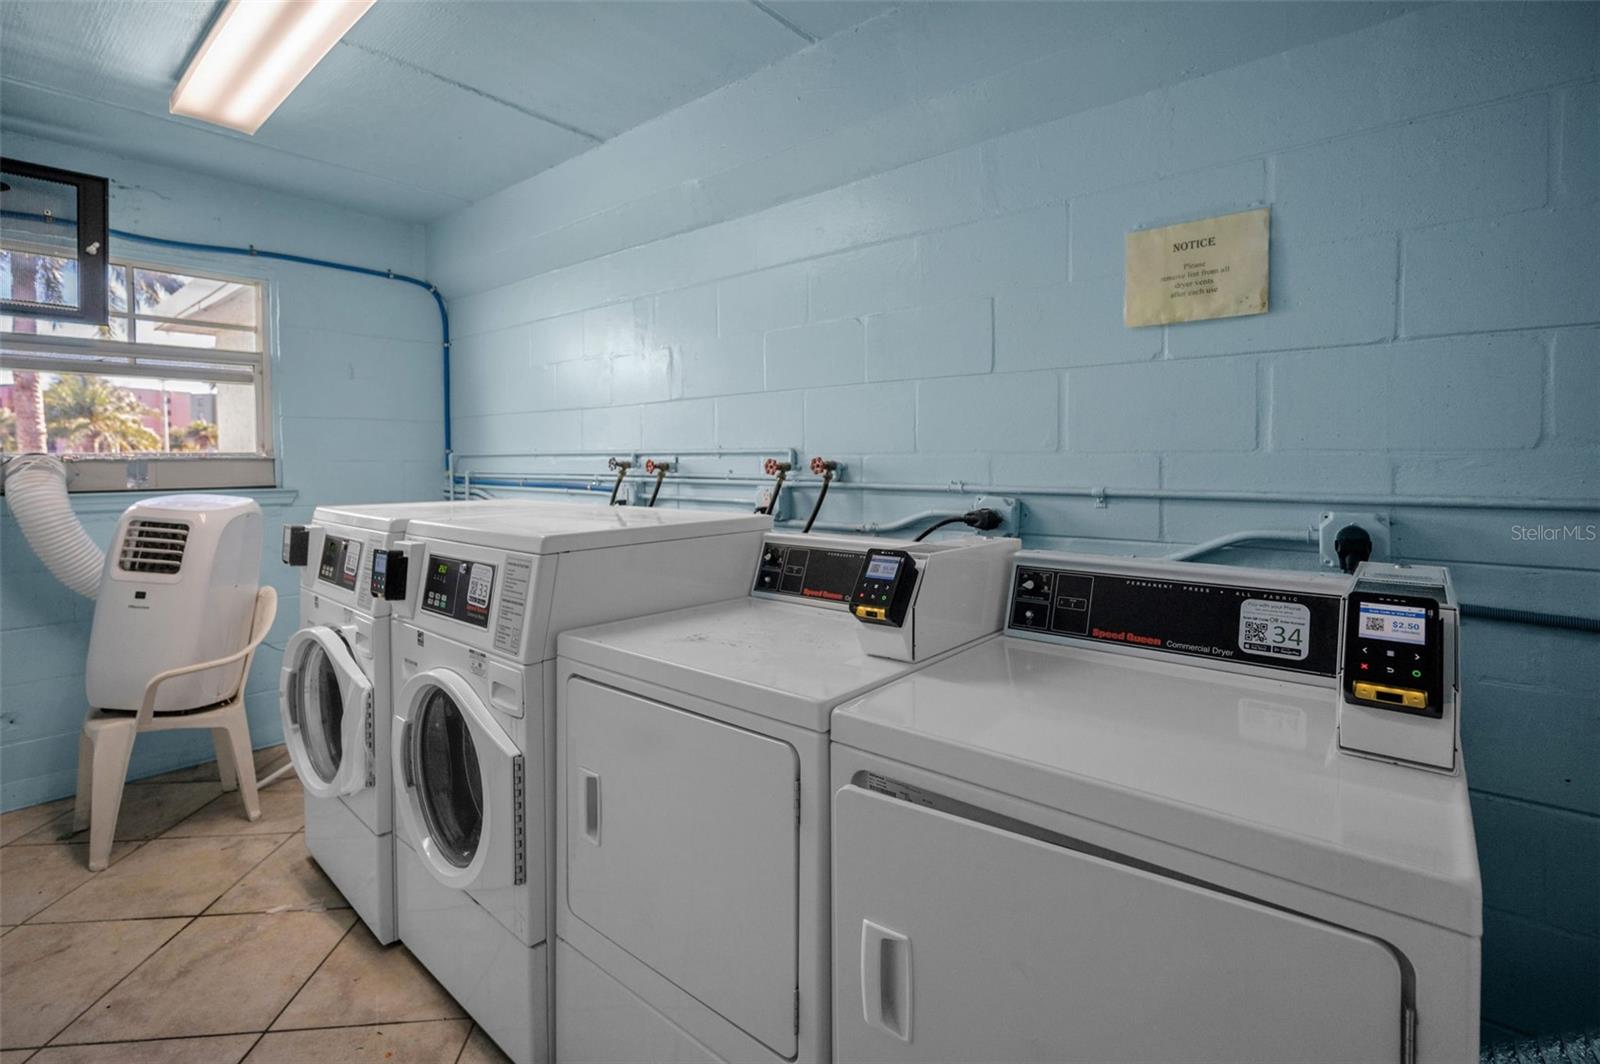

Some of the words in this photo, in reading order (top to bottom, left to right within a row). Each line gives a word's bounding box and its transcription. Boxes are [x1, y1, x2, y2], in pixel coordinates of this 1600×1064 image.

[1173, 237, 1216, 252] NOTICE
[1183, 262, 1206, 270] Please
[1201, 268, 1219, 276] from
[1220, 265, 1230, 273] all
[1174, 280, 1193, 289] dryer
[1194, 278, 1214, 286] vents
[1126, 580, 1173, 589] PERMANENT
[1263, 594, 1298, 602] FABRIC
[1392, 620, 1420, 631] $2.50
[1092, 628, 1125, 641] Speed
[1126, 633, 1161, 646] Queen
[1272, 626, 1303, 646] 34
[1166, 639, 1210, 653] Commercial
[1212, 646, 1235, 657] Dryer
